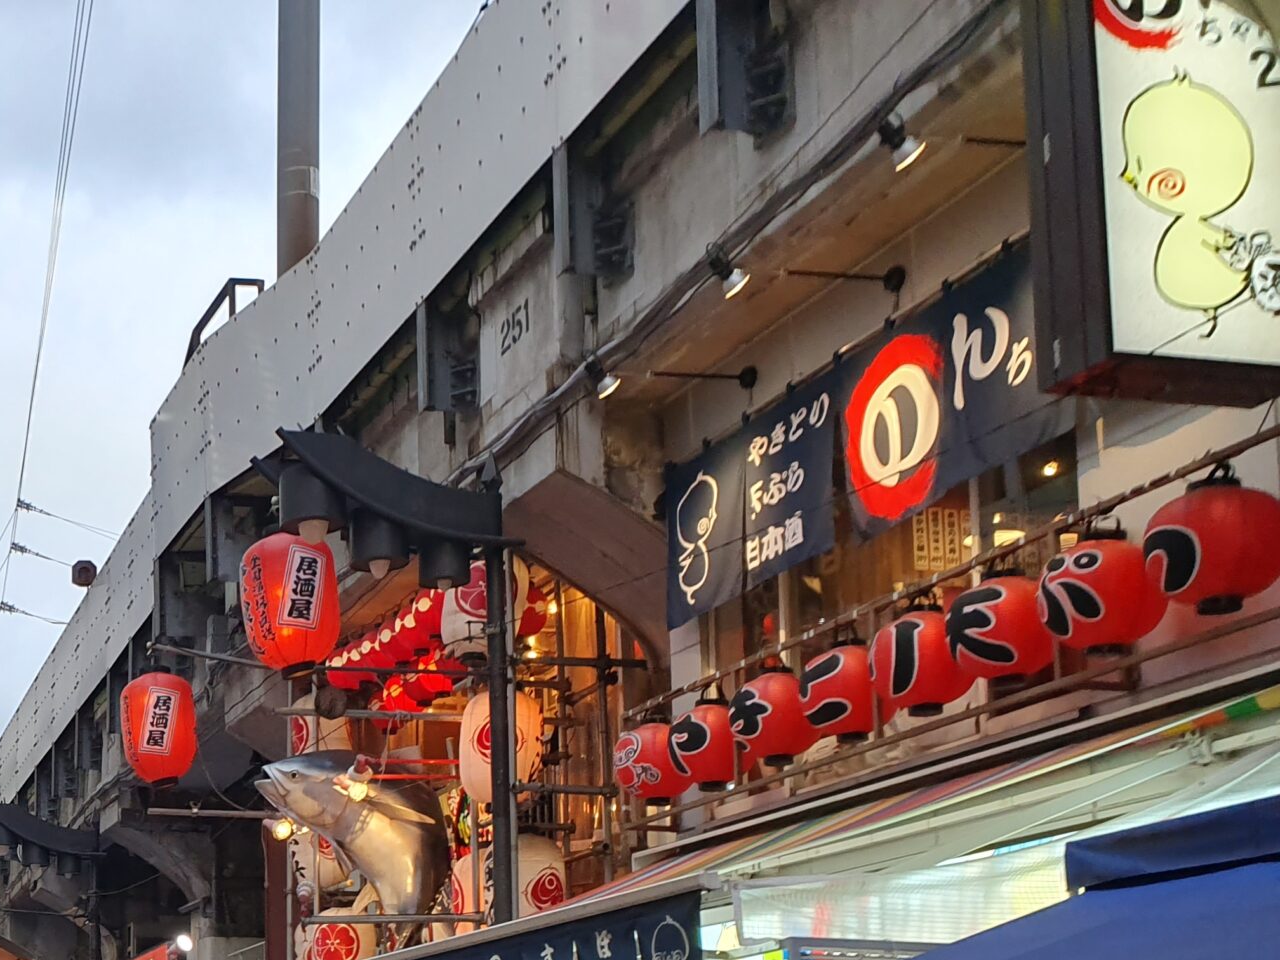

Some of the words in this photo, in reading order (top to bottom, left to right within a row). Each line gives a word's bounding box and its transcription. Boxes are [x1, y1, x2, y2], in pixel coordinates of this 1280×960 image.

[501, 298, 529, 356] 251
[747, 392, 831, 466] やきとり
[748, 460, 805, 521] 天ぷら
[746, 510, 805, 572] 日本酒
[287, 555, 319, 622] 居酒屋
[145, 695, 172, 748] 居酒屋
